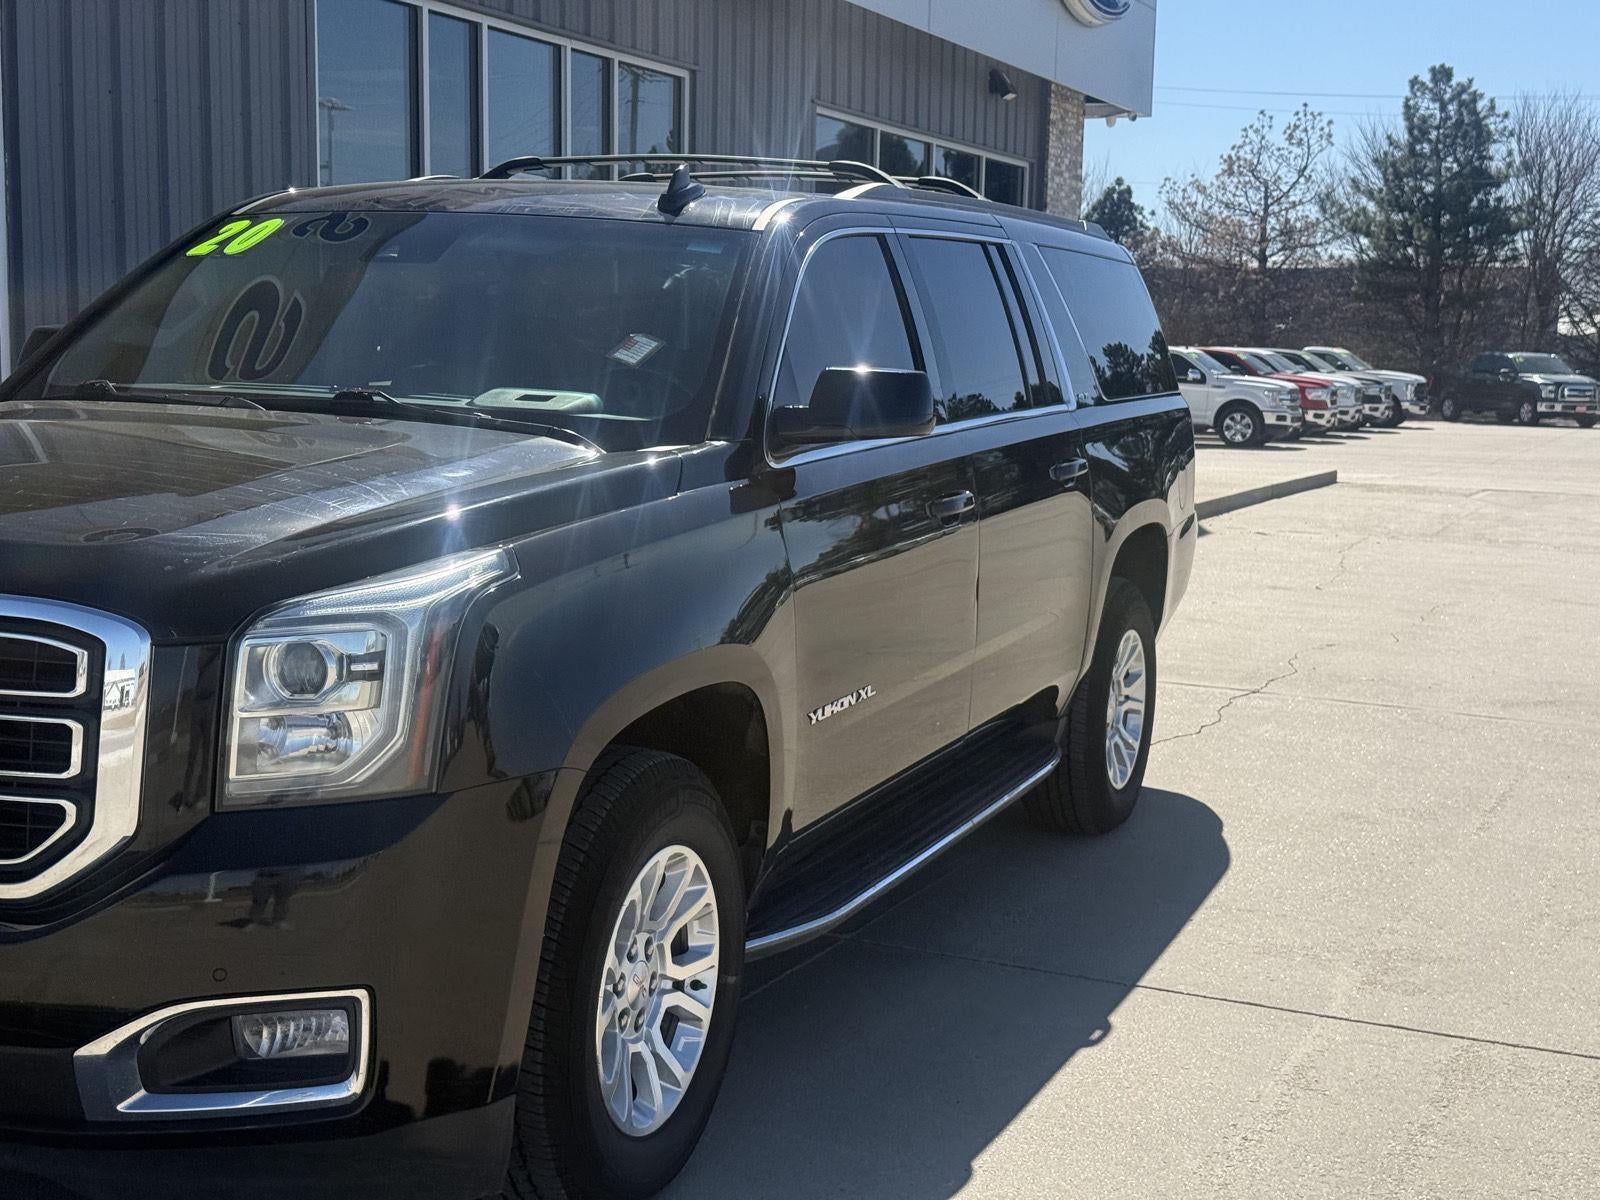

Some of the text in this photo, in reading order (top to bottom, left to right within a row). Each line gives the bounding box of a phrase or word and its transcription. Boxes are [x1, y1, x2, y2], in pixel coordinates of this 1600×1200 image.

[185, 218, 285, 257] 20
[807, 684, 877, 726] YUKON XL
